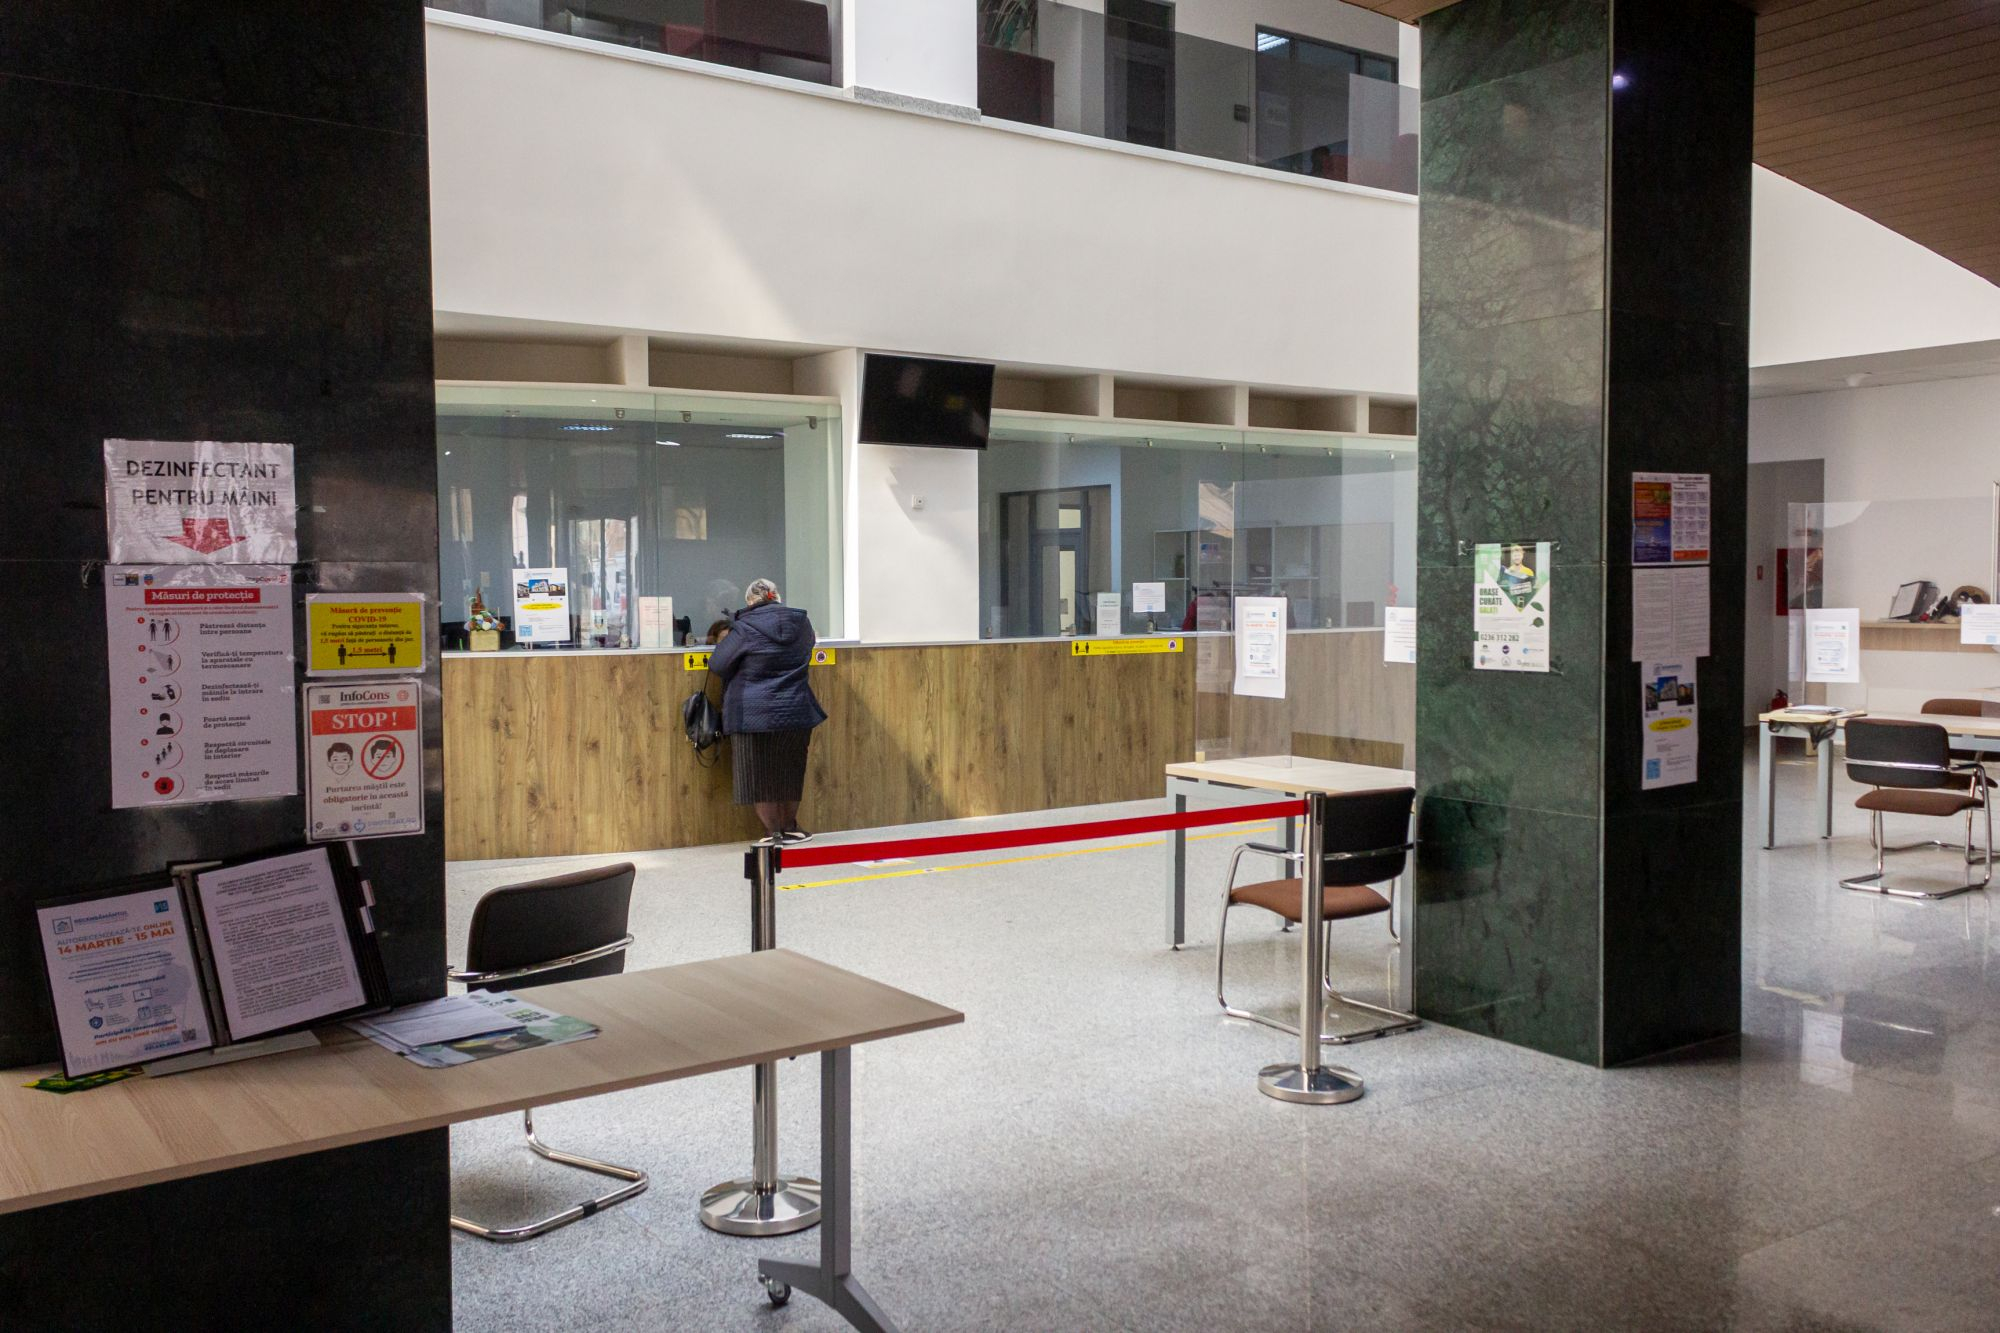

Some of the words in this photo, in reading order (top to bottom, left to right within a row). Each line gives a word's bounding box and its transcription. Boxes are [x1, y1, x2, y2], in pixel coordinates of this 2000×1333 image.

[126, 460, 280, 479] DEZINFECTANT
[132, 489, 214, 506] PENTRU
[222, 486, 277, 507] MÂINI
[151, 591, 190, 601] Măsuri
[192, 590, 205, 600] de
[206, 590, 254, 602] protecție
[1479, 597, 1503, 606] CURATE
[340, 690, 390, 702] InfoCons
[331, 711, 388, 730] STOP
[325, 785, 361, 794] Purtarea
[363, 782, 388, 791] măștii
[323, 793, 369, 804] obligatorie
[378, 790, 409, 799] această
[142, 920, 174, 931] ONLINE
[57, 946, 72, 955] 14
[75, 936, 125, 953] MARTIE
[134, 932, 149, 942] 15
[150, 927, 176, 939] MAI
